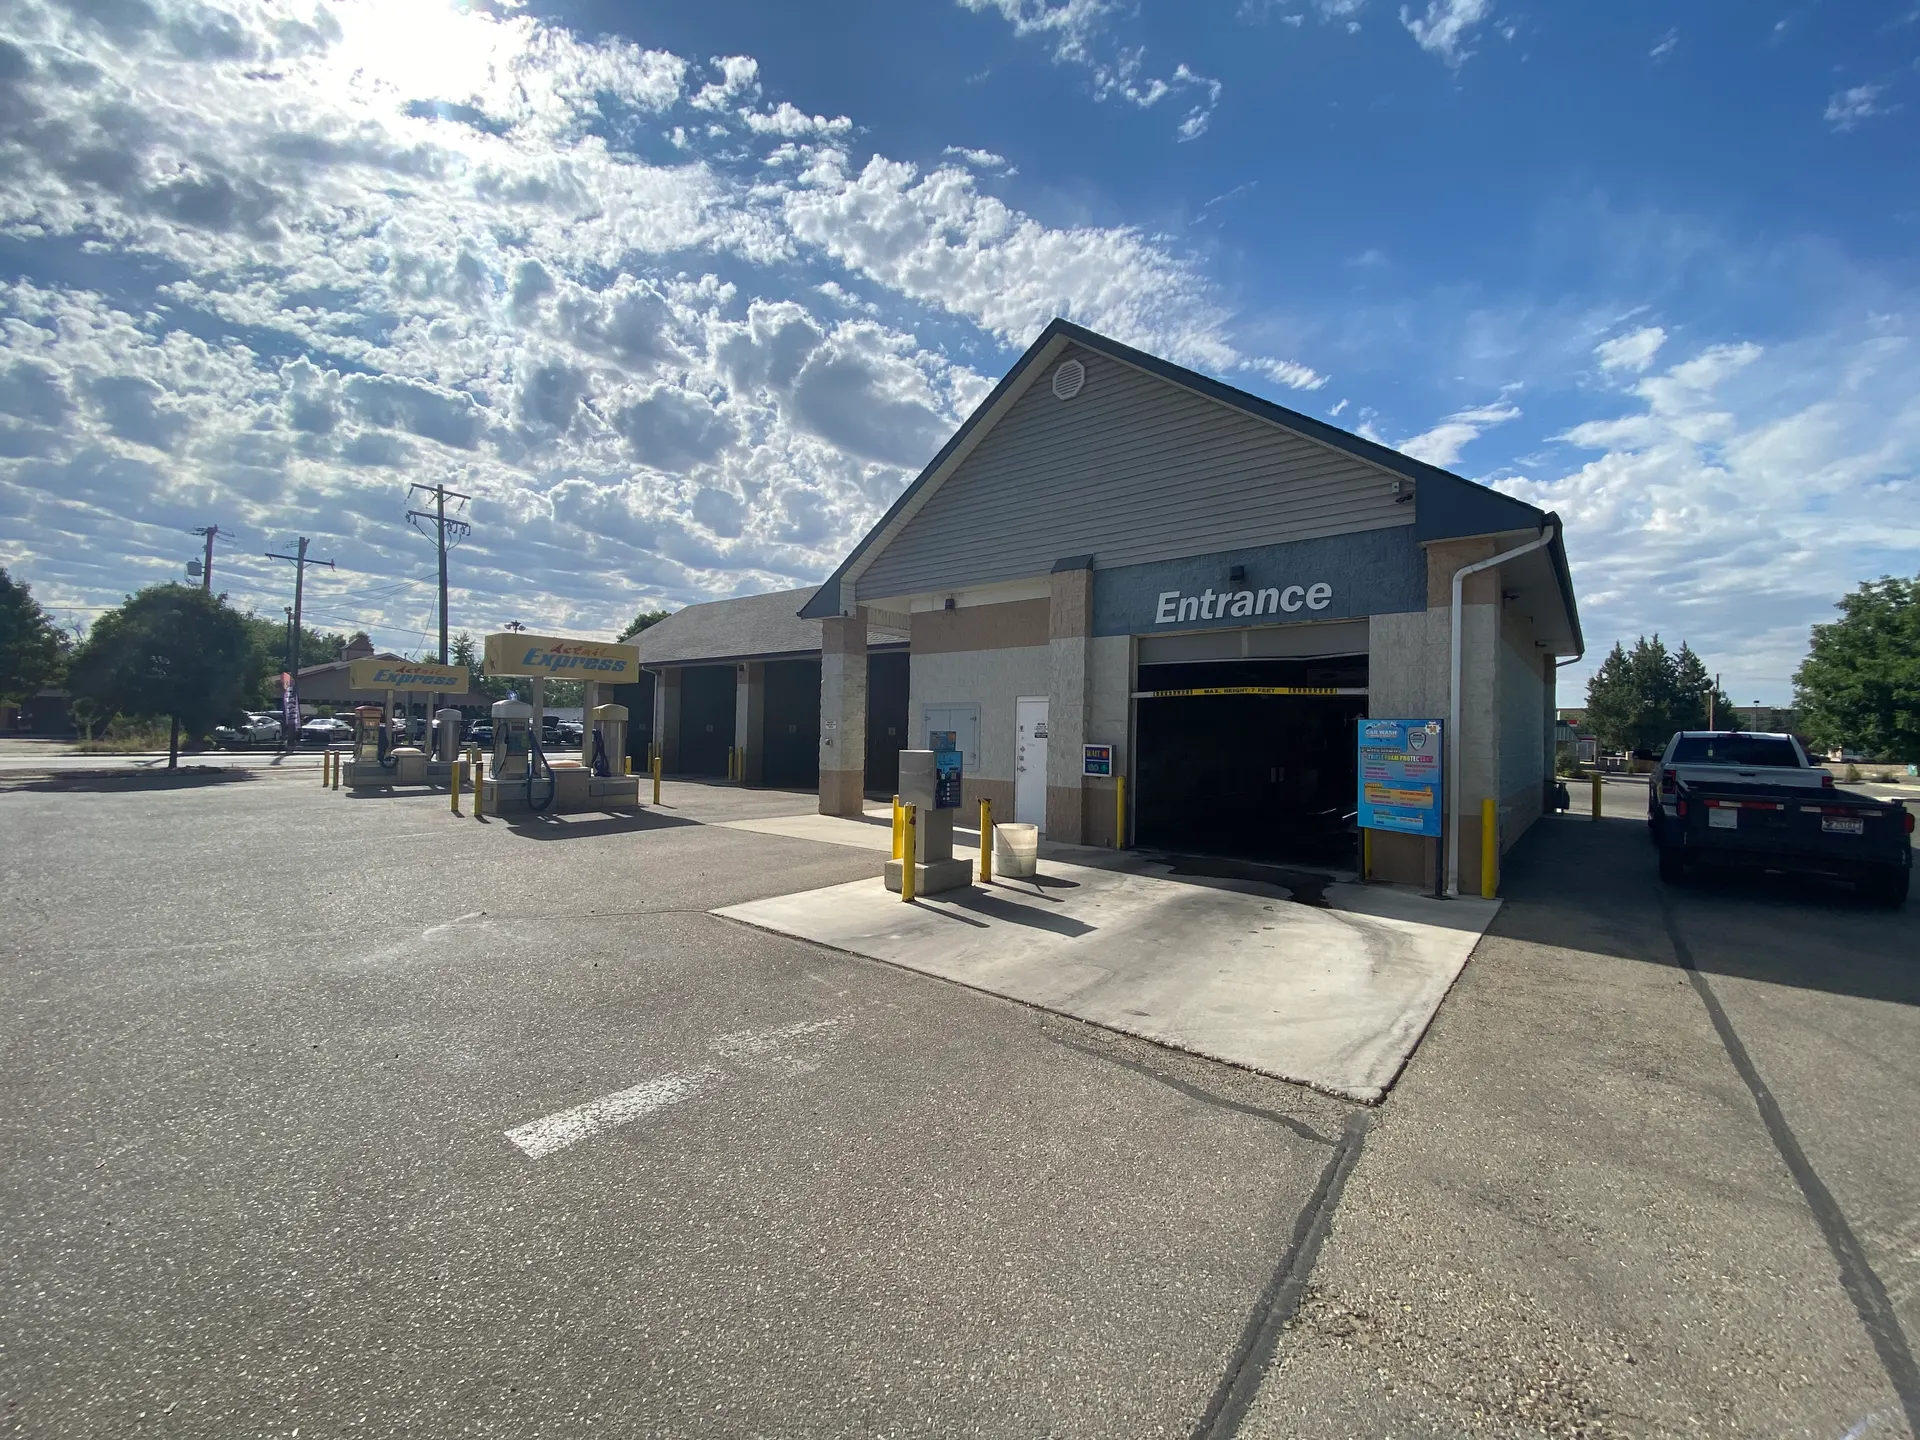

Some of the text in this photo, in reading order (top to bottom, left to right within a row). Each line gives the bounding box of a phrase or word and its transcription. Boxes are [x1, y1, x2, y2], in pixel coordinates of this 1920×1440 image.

[1155, 582, 1333, 624] Entrance
[521, 647, 627, 672] Express
[373, 669, 458, 686] Express
